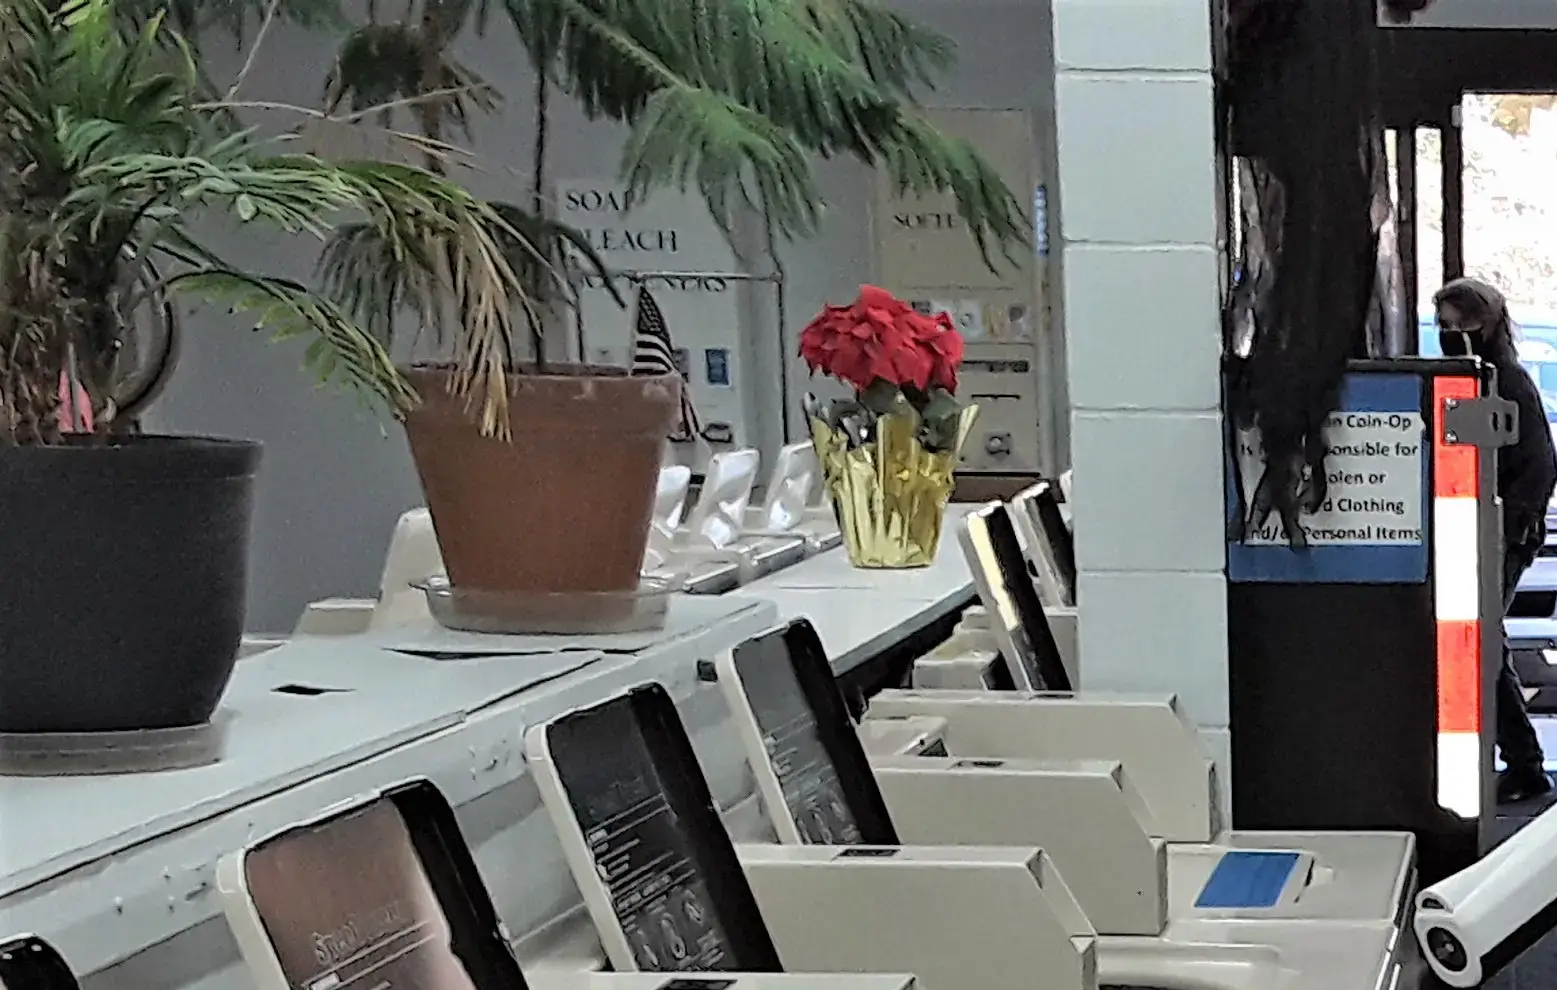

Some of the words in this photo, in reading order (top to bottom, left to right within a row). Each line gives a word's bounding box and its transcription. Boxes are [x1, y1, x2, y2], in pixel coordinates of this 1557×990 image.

[566, 188, 635, 212] SOAP
[584, 229, 678, 252] LEACH
[1346, 414, 1412, 431] Coin-Op
[1327, 442, 1390, 457] onsible
[1395, 442, 1418, 457] for
[1328, 470, 1363, 485] olen
[1368, 472, 1387, 485] or
[1338, 498, 1405, 515] Clothing
[1376, 525, 1423, 540] Items
